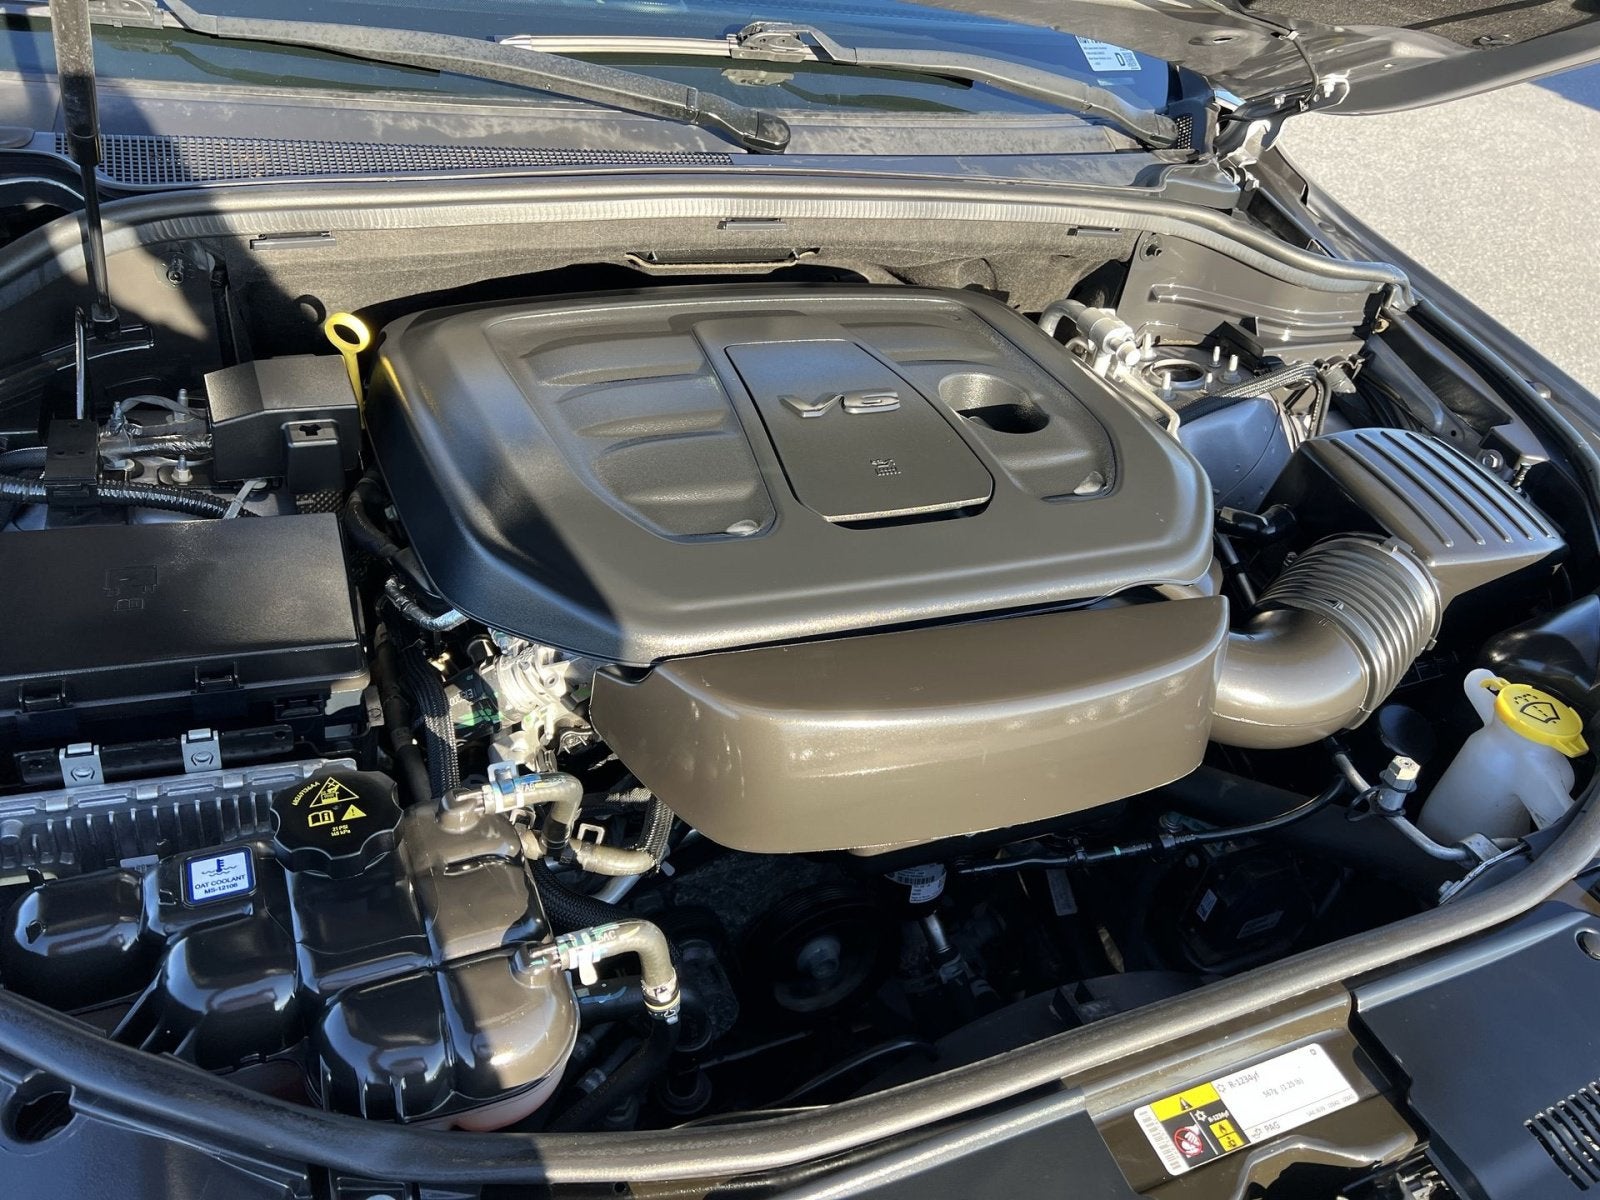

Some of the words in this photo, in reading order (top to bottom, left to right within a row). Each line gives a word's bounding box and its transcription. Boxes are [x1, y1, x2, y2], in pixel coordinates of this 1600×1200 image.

[776, 387, 901, 418] V6
[195, 881, 210, 890] OAT
[211, 874, 246, 887] COOLANT
[1264, 1121, 1281, 1133] PAG
